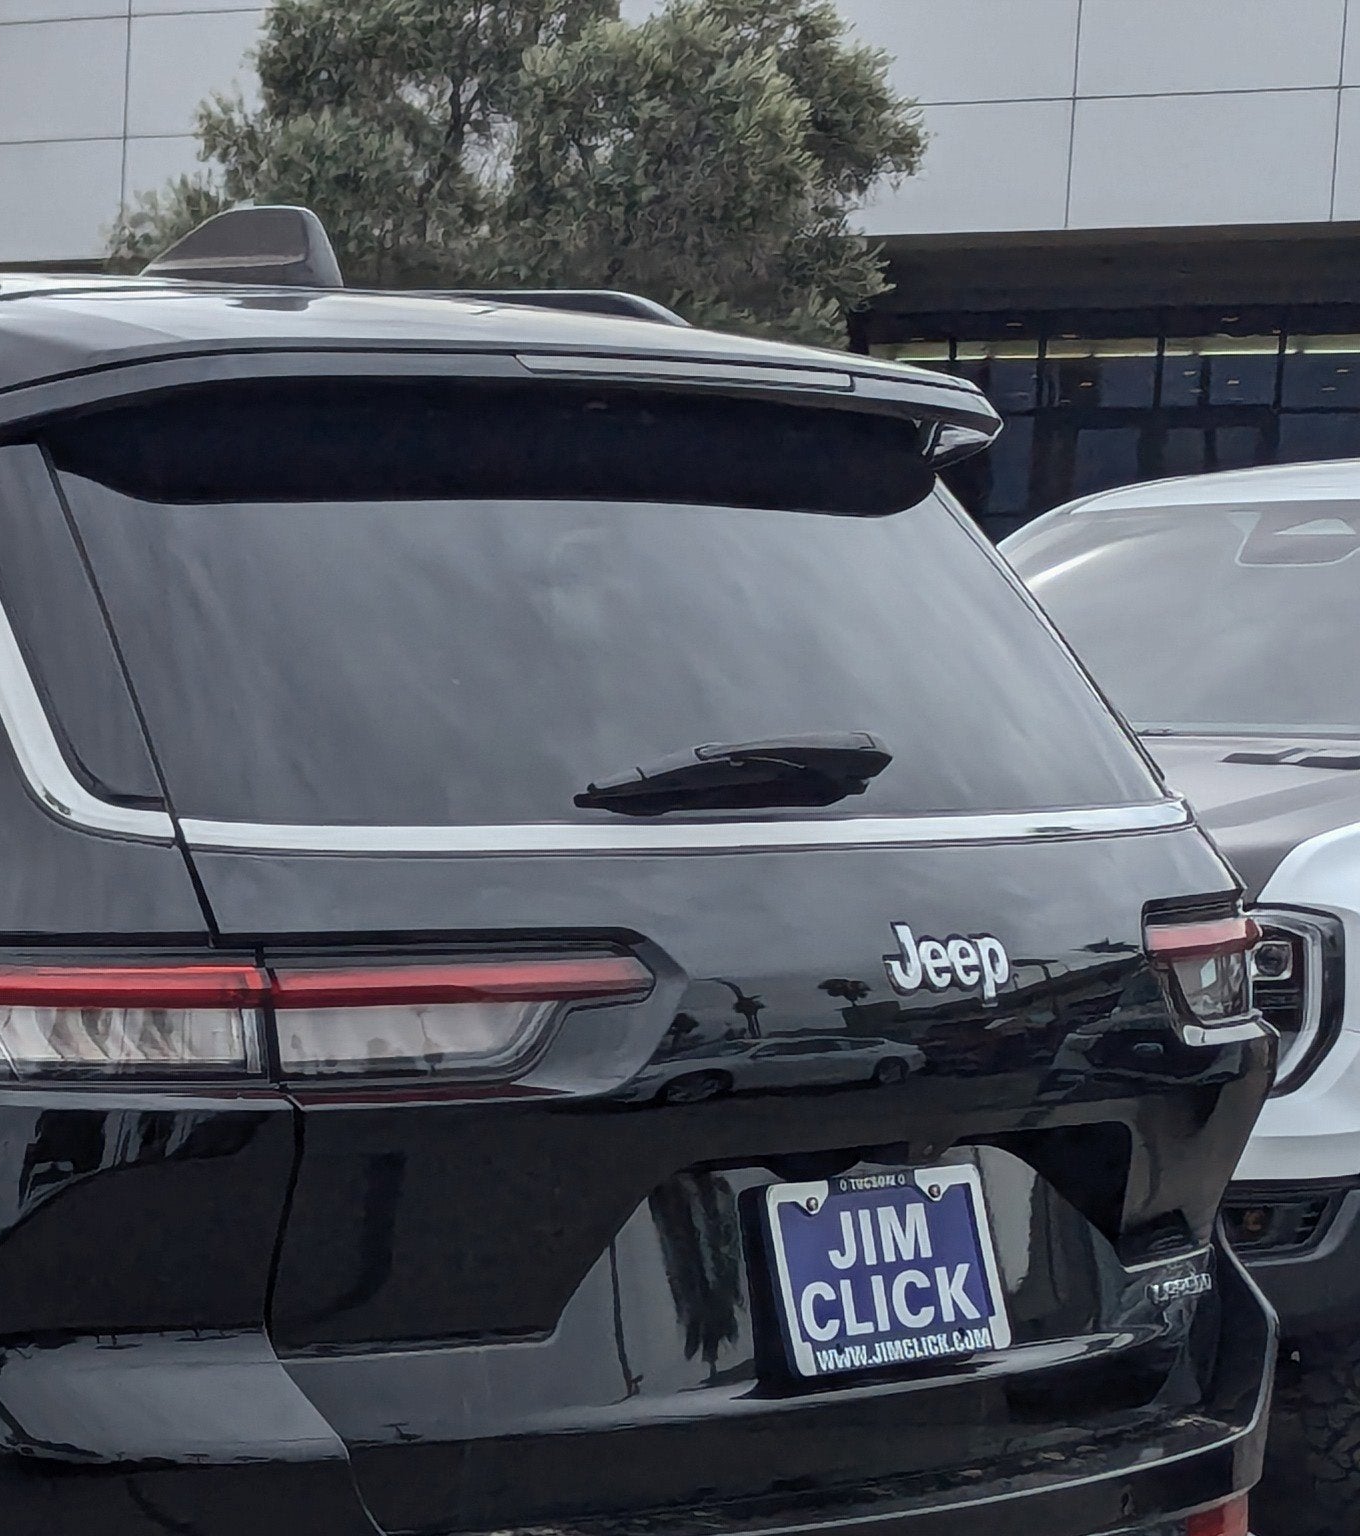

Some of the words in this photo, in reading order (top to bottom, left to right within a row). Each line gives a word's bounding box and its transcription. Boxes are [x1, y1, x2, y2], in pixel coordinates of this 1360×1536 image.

[882, 922, 1010, 1003] Jeep
[849, 1174, 896, 1190] TUCSON
[828, 1202, 933, 1269] JIM
[800, 1263, 981, 1341] CLICK
[816, 1327, 992, 1371] WWW.JIMCLICK.COM
